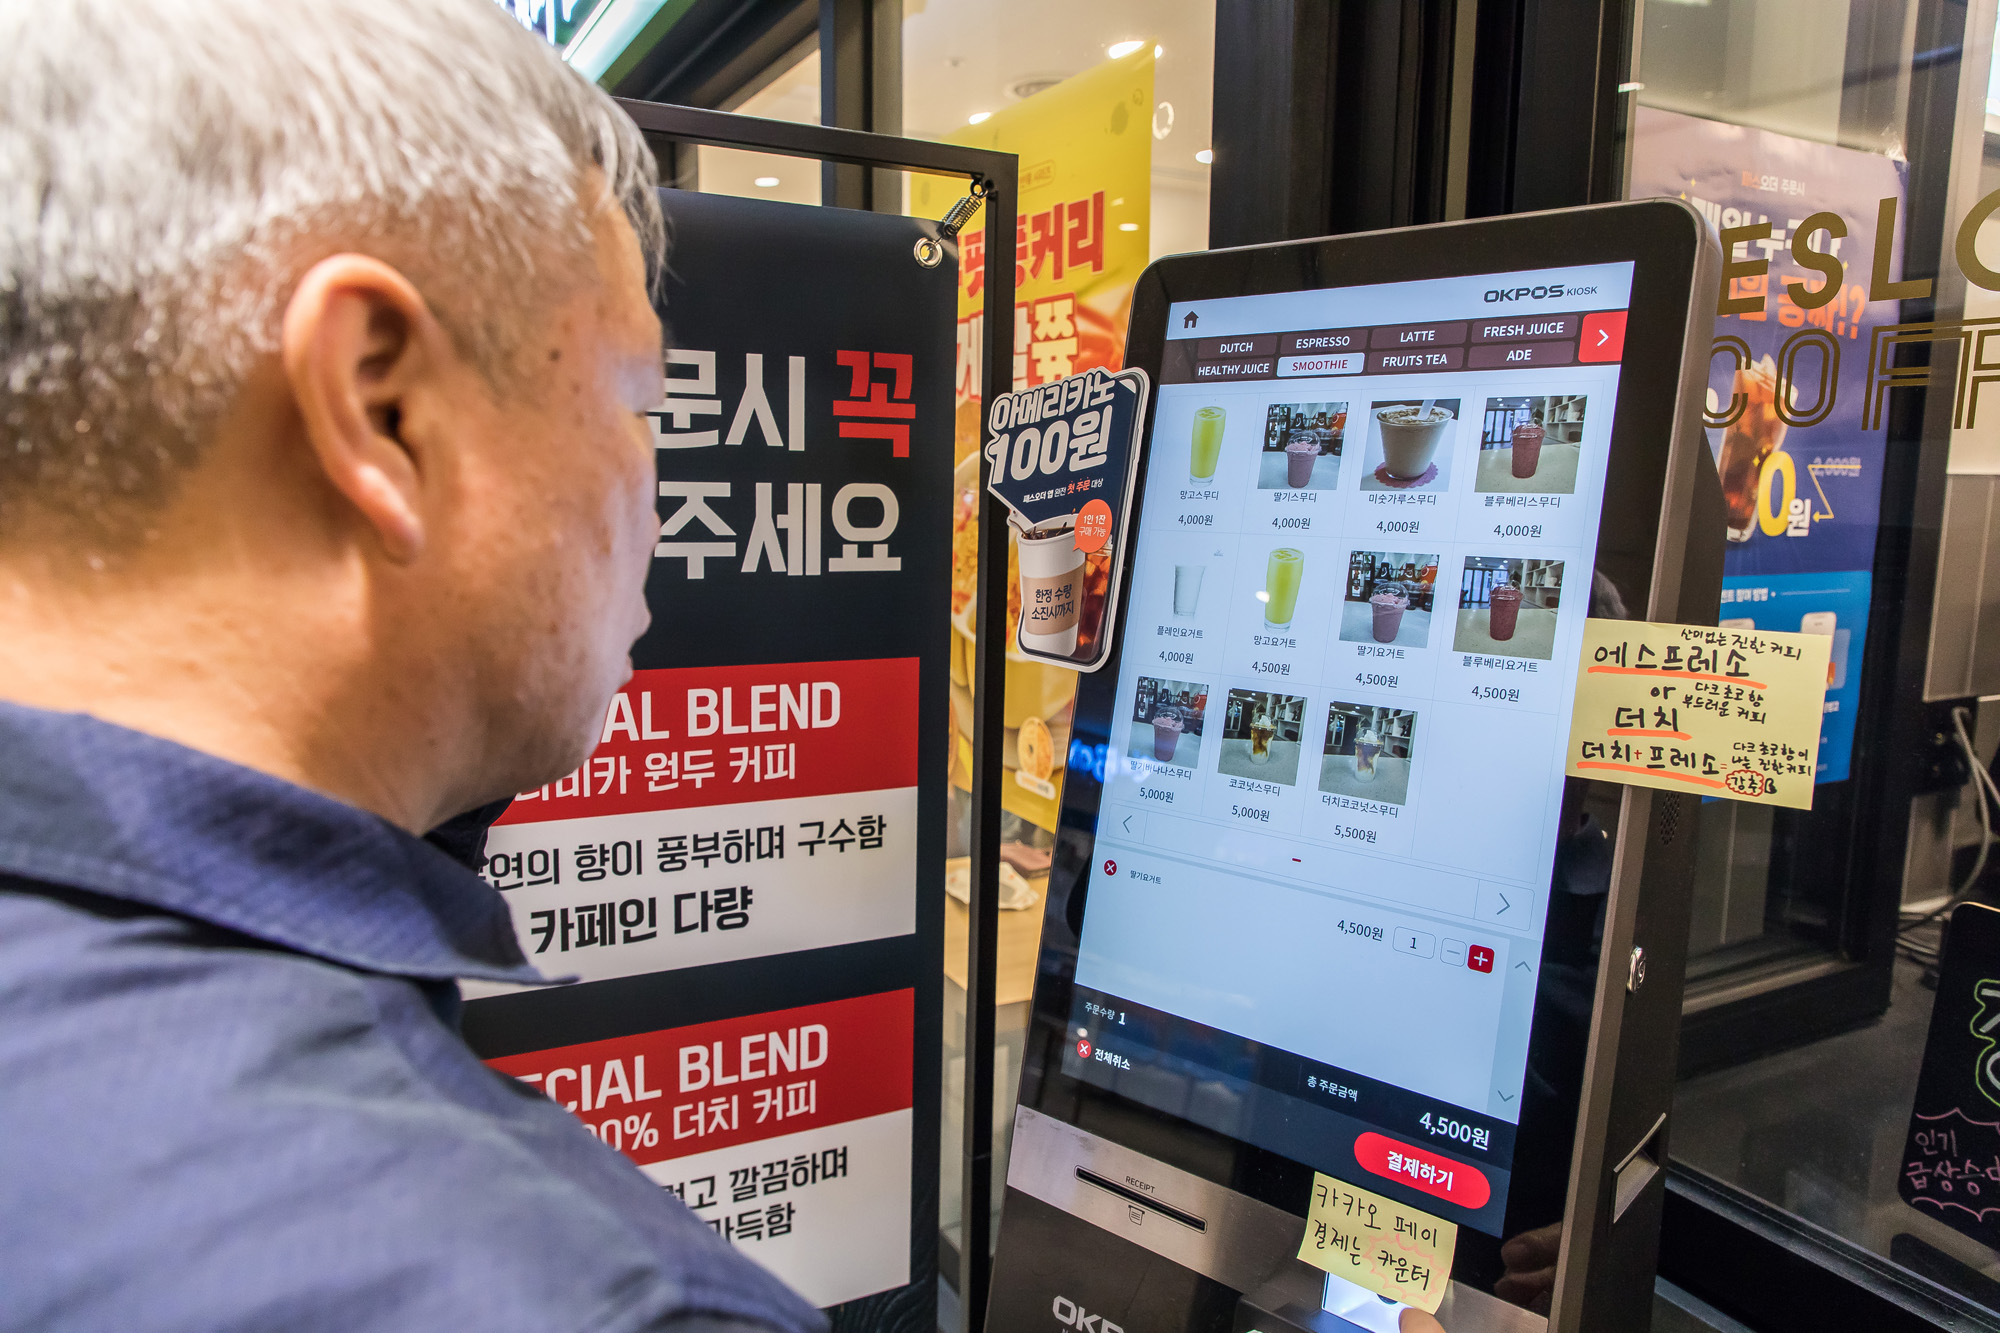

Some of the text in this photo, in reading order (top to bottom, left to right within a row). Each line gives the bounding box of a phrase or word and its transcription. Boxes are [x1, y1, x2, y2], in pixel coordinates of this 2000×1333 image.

[1484, 284, 1598, 303] OKPOS KIOSK
[1400, 330, 1435, 342] LATTE
[1483, 321, 1564, 336] FRESH JUICE
[1220, 342, 1253, 354] DUTCH
[1295, 335, 1350, 349] ESPRESSO
[1382, 354, 1448, 367] FRUITS TEA
[1506, 349, 1532, 362] ADE
[1198, 363, 1270, 376] HEALTHY JUICE
[1292, 359, 1348, 372] SMOOTHIE
[832, 349, 916, 458] 꼭
[991, 371, 1116, 432] 아메리카노
[988, 404, 1114, 486] 100원
[1076, 476, 1091, 492] 주문
[1758, 450, 1811, 537] 0원
[1180, 490, 1219, 501] 망고스무디
[1273, 492, 1317, 503] 딸기스무디
[1368, 494, 1437, 506] 미숫가루스무디
[1484, 496, 1560, 508] 블루베리스무디
[1083, 514, 1106, 525] 1인 1잔
[1178, 514, 1214, 526] 4,000원
[1271, 517, 1311, 530] 4,000원
[1376, 521, 1420, 534] 4,000원
[654, 480, 901, 579] 주세요
[1079, 526, 1106, 537] 구매 가능
[1493, 524, 1542, 538] 4,000원
[1035, 583, 1072, 603] 한정 수량
[1031, 600, 1074, 620] 소진시까지
[1157, 625, 1203, 639] 플레인요거트
[1253, 635, 1297, 649] 망고요거트
[1681, 628, 1801, 660] 산미없는 진한 커피
[1158, 650, 1194, 665] 4,000원
[1357, 645, 1405, 660] 딸기요거트
[1594, 642, 1750, 677] 에스프레소
[1251, 661, 1291, 676] 4,500원
[1462, 655, 1538, 673] 블루베리요거트
[1355, 672, 1398, 689] 4,500원
[1471, 685, 1520, 702] 4,500원
[1650, 686, 1676, 699] or
[687, 681, 841, 737] BLEND
[1682, 694, 1766, 724] 부드러운 커피
[1615, 706, 1679, 732] 더치
[644, 751, 716, 793] 원두
[729, 743, 797, 784] 커피
[1130, 760, 1192, 781] 딸기바나나스무디
[1731, 755, 1752, 770] 나는
[1786, 763, 1812, 777] 커피
[1229, 778, 1281, 797] 코코넛스무디
[1731, 776, 1759, 793] 강추
[1139, 787, 1174, 804] 5,000원
[1231, 805, 1270, 823] 5,000원
[1322, 795, 1399, 818] 더치코코넛스무디
[1334, 825, 1377, 844] 5,500원
[480, 814, 887, 891] 연의 향이 풍부하며 구수함
[530, 885, 754, 954] 카페인 다량
[1337, 919, 1417, 950] 4,500원 1
[1085, 1001, 1126, 1026] 주문수량 1
[515, 1023, 829, 1114] CIAL BLEND
[1094, 1048, 1131, 1071] 전체취소
[1307, 1075, 1358, 1103] 총 주문금액
[672, 1094, 739, 1140] 더치
[752, 1079, 817, 1124] 커피
[1419, 1112, 1490, 1151] 4,500원
[1915, 1129, 1958, 1158] 인기
[729, 1146, 849, 1202] 깔끔하며
[1387, 1150, 1454, 1192] 결제하기
[1125, 1175, 1156, 1194] RECEIPT
[1316, 1183, 1437, 1248] 카카오 페이
[1314, 1219, 1430, 1291] 결제는 카운터
